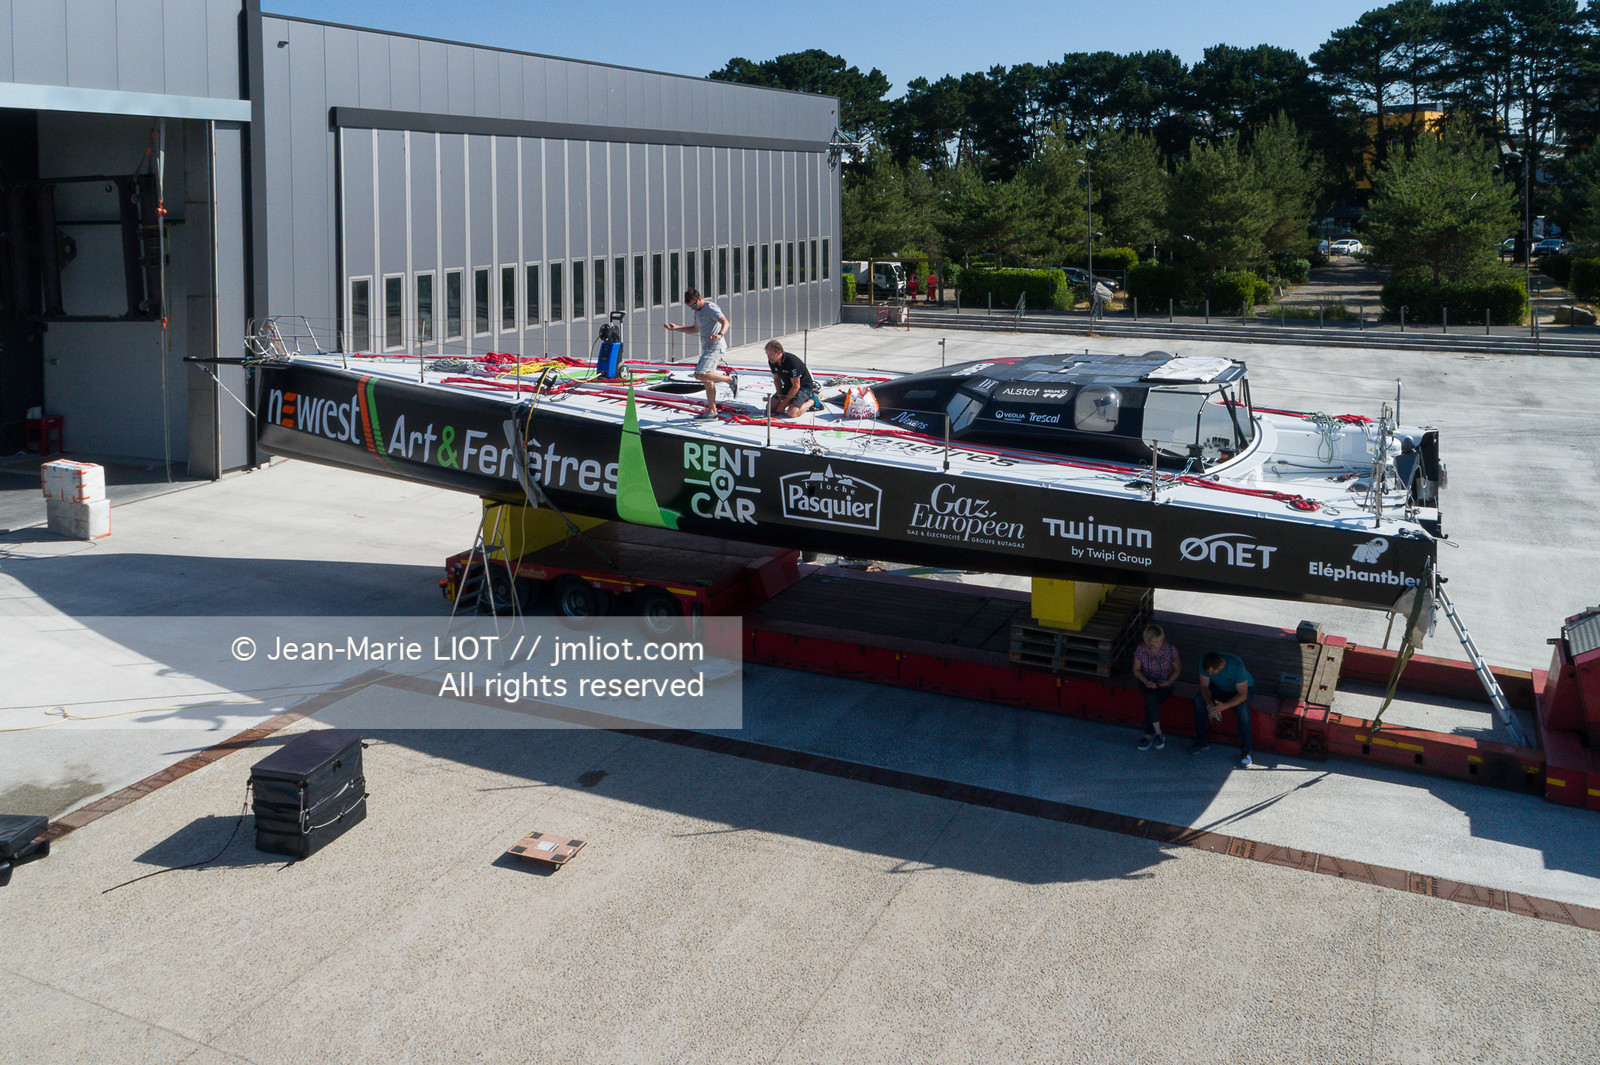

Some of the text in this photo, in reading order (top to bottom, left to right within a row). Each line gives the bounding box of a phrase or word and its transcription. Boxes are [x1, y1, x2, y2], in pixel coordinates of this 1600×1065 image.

[891, 411, 928, 429] Nexans
[1029, 411, 1060, 423] Trescal
[684, 442, 761, 478] RENT
[789, 484, 874, 519] Pasquier
[805, 482, 855, 495] bioche
[930, 482, 990, 518] Gaz
[691, 492, 758, 525] CAR
[908, 503, 1025, 541] Européen
[971, 537, 995, 545] GROUPE
[997, 540, 1025, 549] BUTAGAZ
[1071, 545, 1152, 567] by Twipi Group
